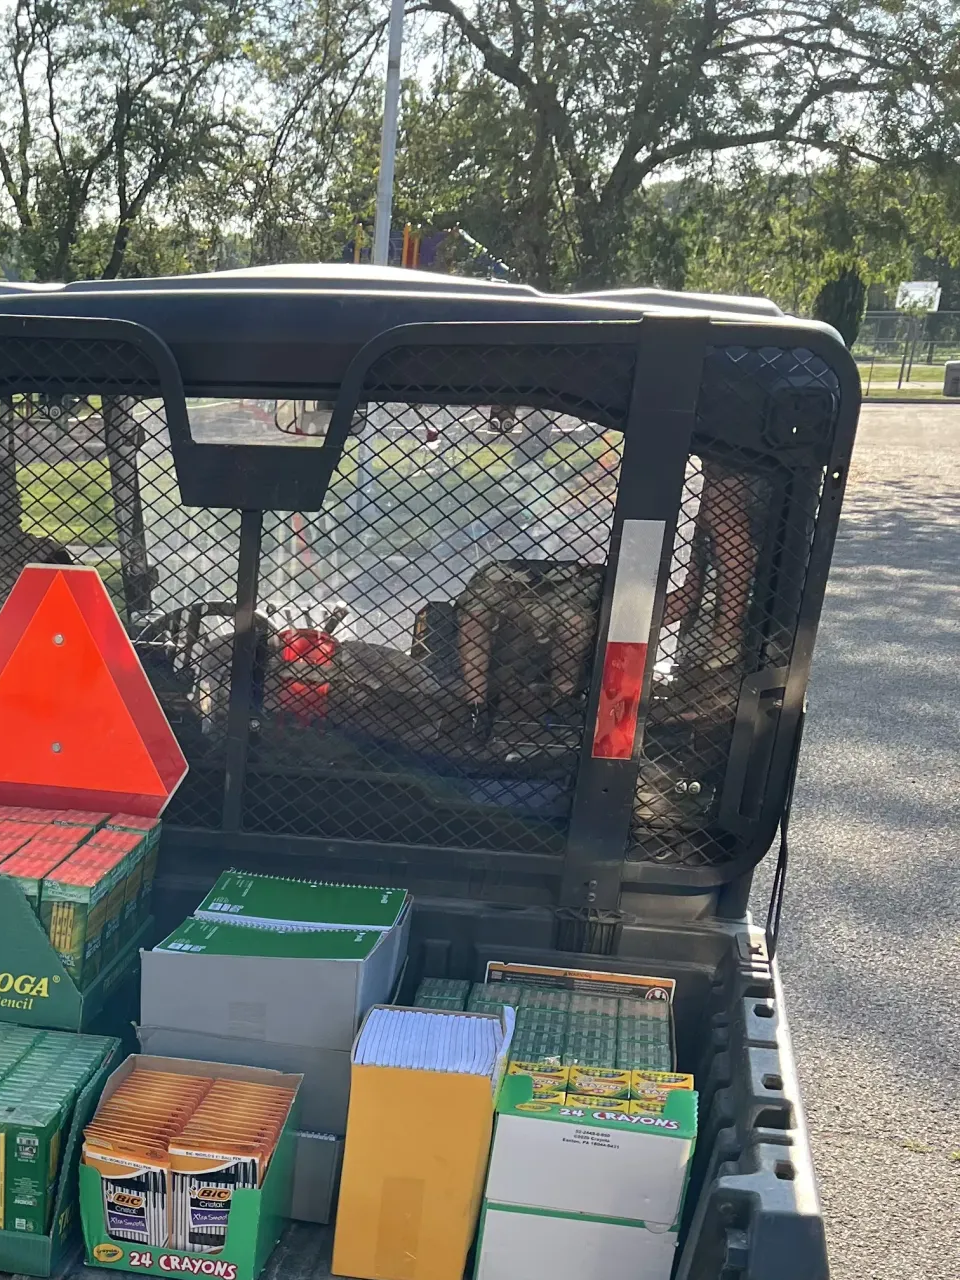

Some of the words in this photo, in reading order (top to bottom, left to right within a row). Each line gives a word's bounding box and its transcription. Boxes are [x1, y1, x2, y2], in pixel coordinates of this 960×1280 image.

[560, 1108, 585, 1117] 24
[593, 1111, 680, 1129] CRAYONS
[129, 1251, 153, 1267] 24
[159, 1255, 237, 1280] CRAYONS
